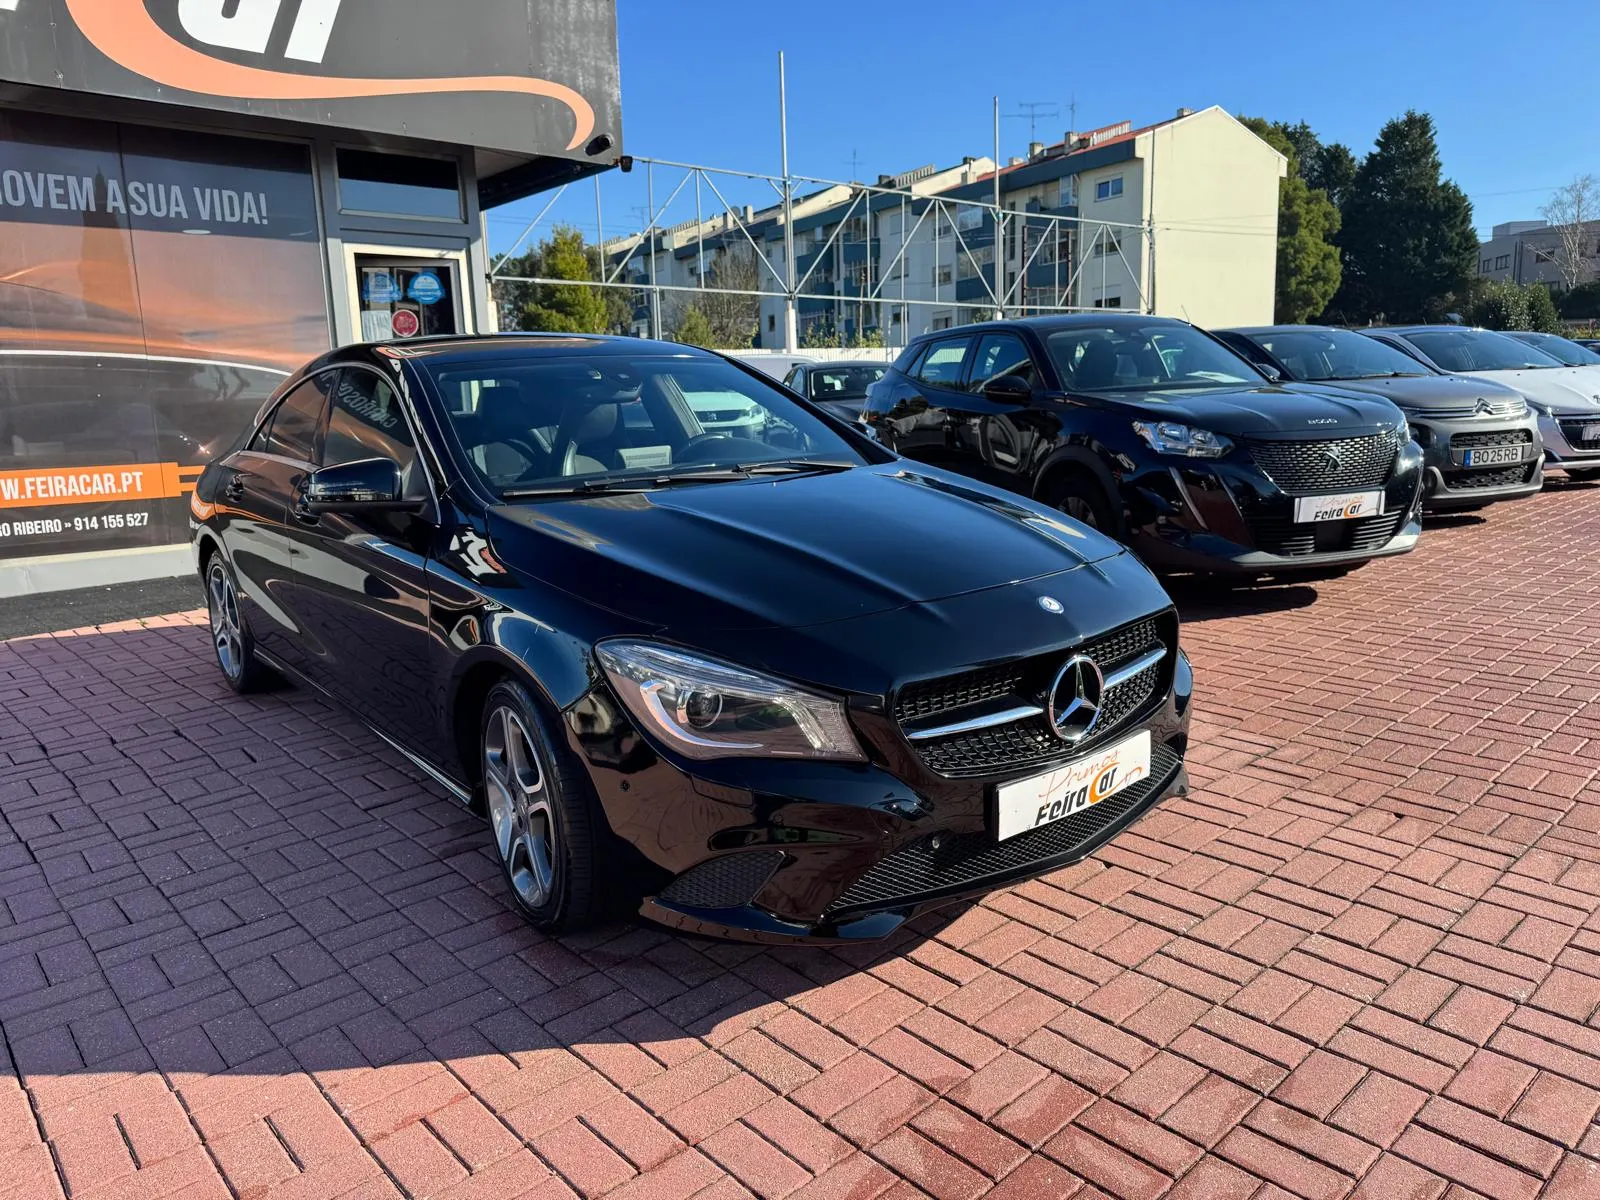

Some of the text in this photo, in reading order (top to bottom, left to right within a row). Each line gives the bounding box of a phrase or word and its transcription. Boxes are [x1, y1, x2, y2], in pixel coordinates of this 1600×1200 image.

[0, 169, 97, 212] OVEM
[193, 187, 268, 225] VIDA!
[13, 518, 62, 536] RIBEIRO
[74, 515, 99, 531] 914
[101, 514, 125, 529] 155
[126, 512, 149, 527] 527
